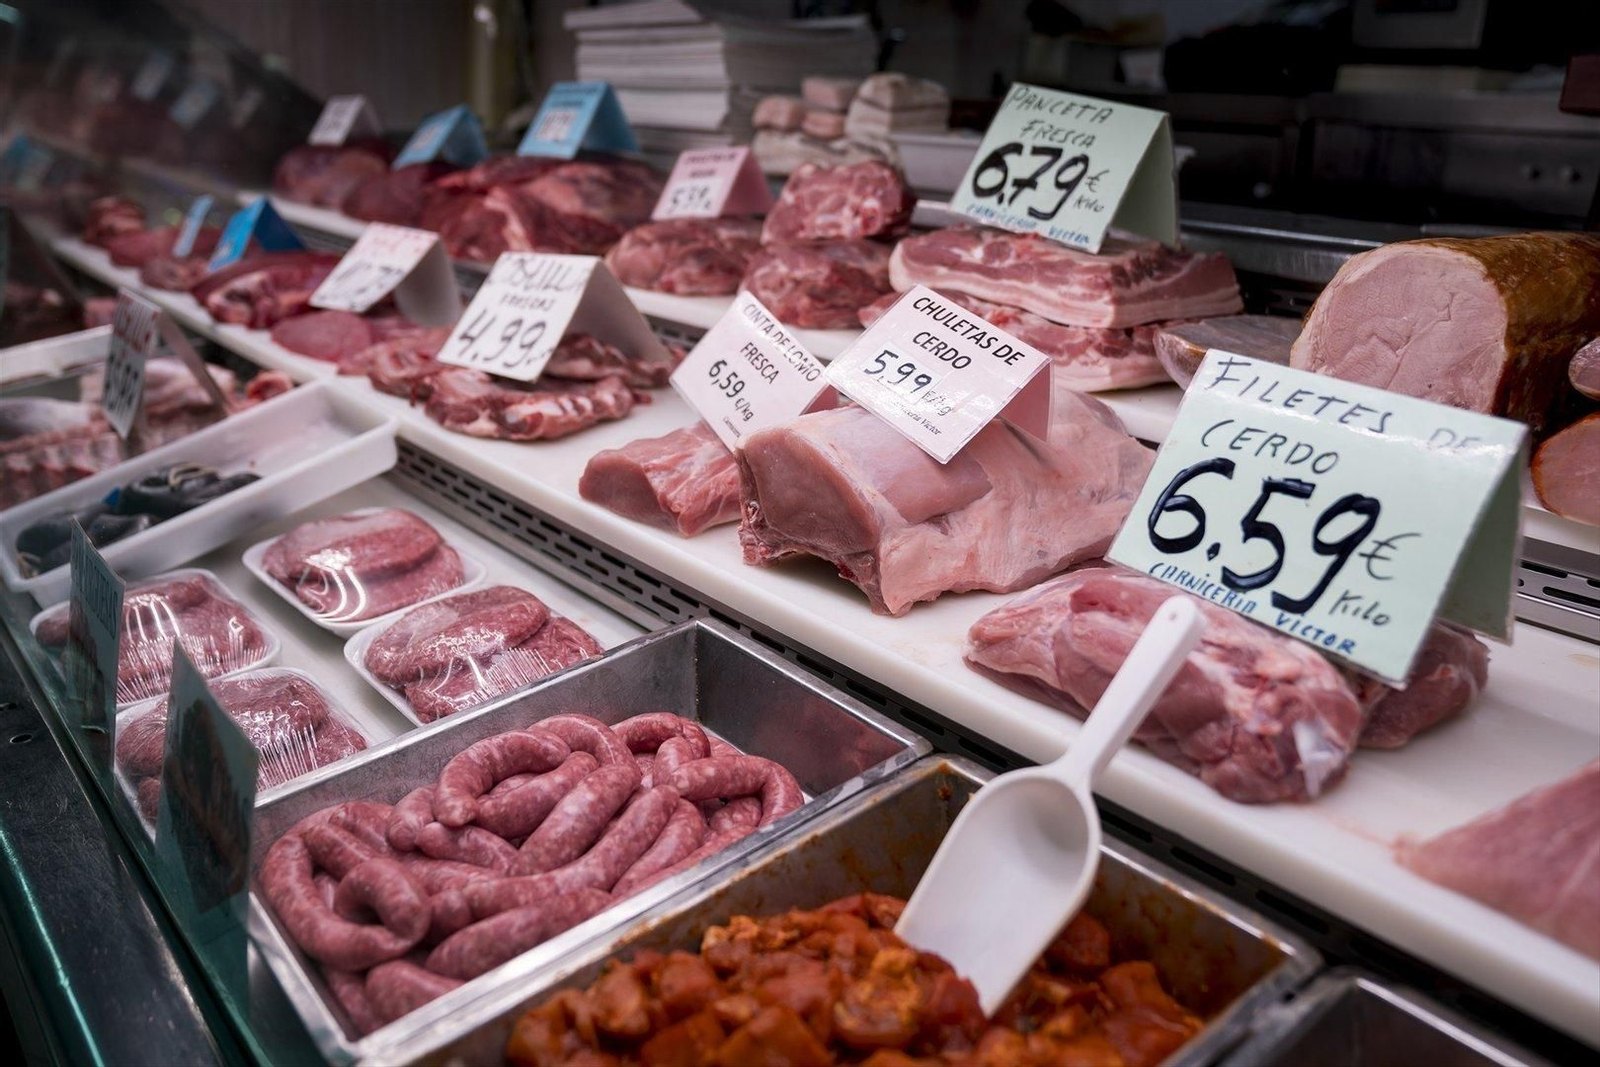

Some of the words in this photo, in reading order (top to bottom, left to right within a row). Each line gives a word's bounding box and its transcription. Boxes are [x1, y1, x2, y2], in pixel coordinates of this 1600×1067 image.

[1012, 86, 1114, 124] PANCETA
[1019, 119, 1096, 149] FRESCA
[743, 303, 775, 336] CINTA
[912, 297, 999, 349] CHULETAS
[992, 344, 1026, 366] DE
[739, 341, 780, 385] FRESCA
[912, 331, 972, 369] CERDO
[708, 359, 746, 399] 6,59
[1206, 356, 1396, 434] FILETES
[920, 418, 942, 435] Victor
[1201, 418, 1340, 475] CERDO
[1147, 456, 1381, 614] 6.59
[1360, 532, 1422, 581] €
